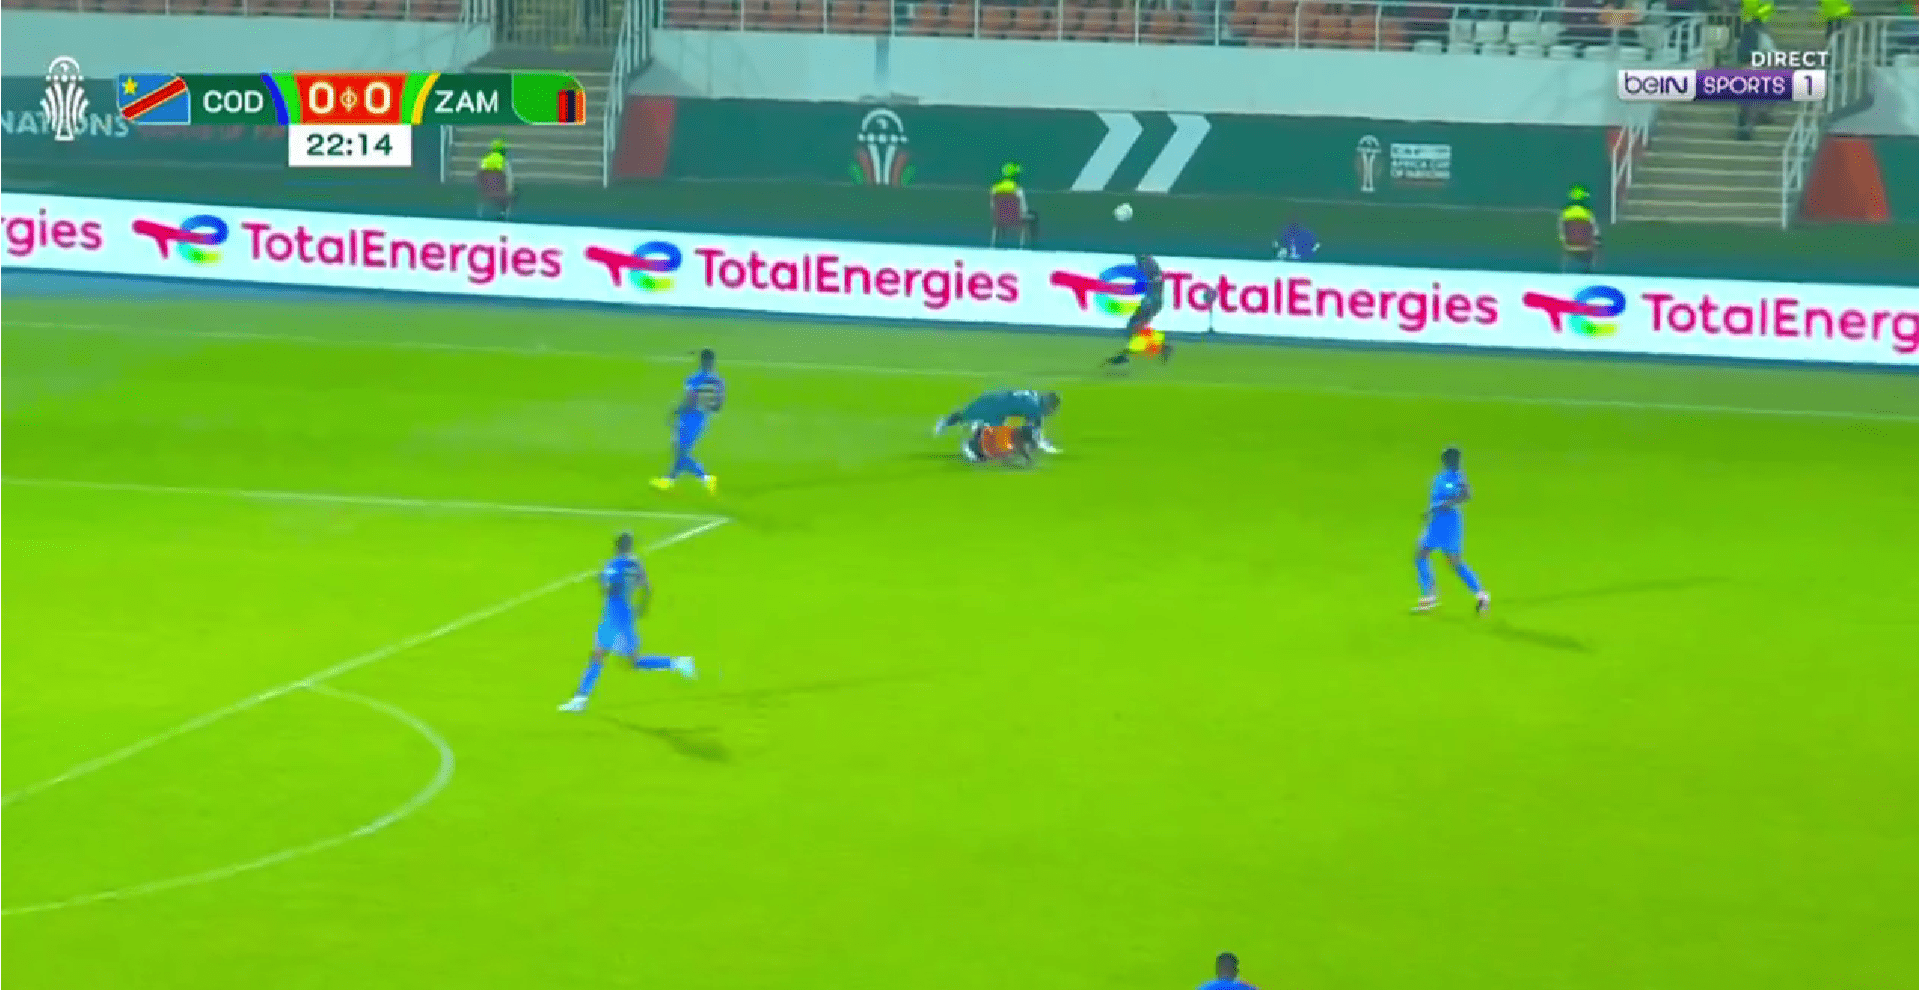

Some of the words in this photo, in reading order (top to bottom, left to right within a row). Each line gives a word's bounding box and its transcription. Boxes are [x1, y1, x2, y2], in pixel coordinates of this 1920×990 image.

[1, 110, 129, 138] NATNS
[1, 207, 102, 258] gies
[241, 221, 563, 286] TotalEnergies
[694, 247, 1020, 310] TotalEnergies
[1161, 269, 1498, 333] TotalEnergies
[1640, 292, 1919, 354] TotalEnerg
